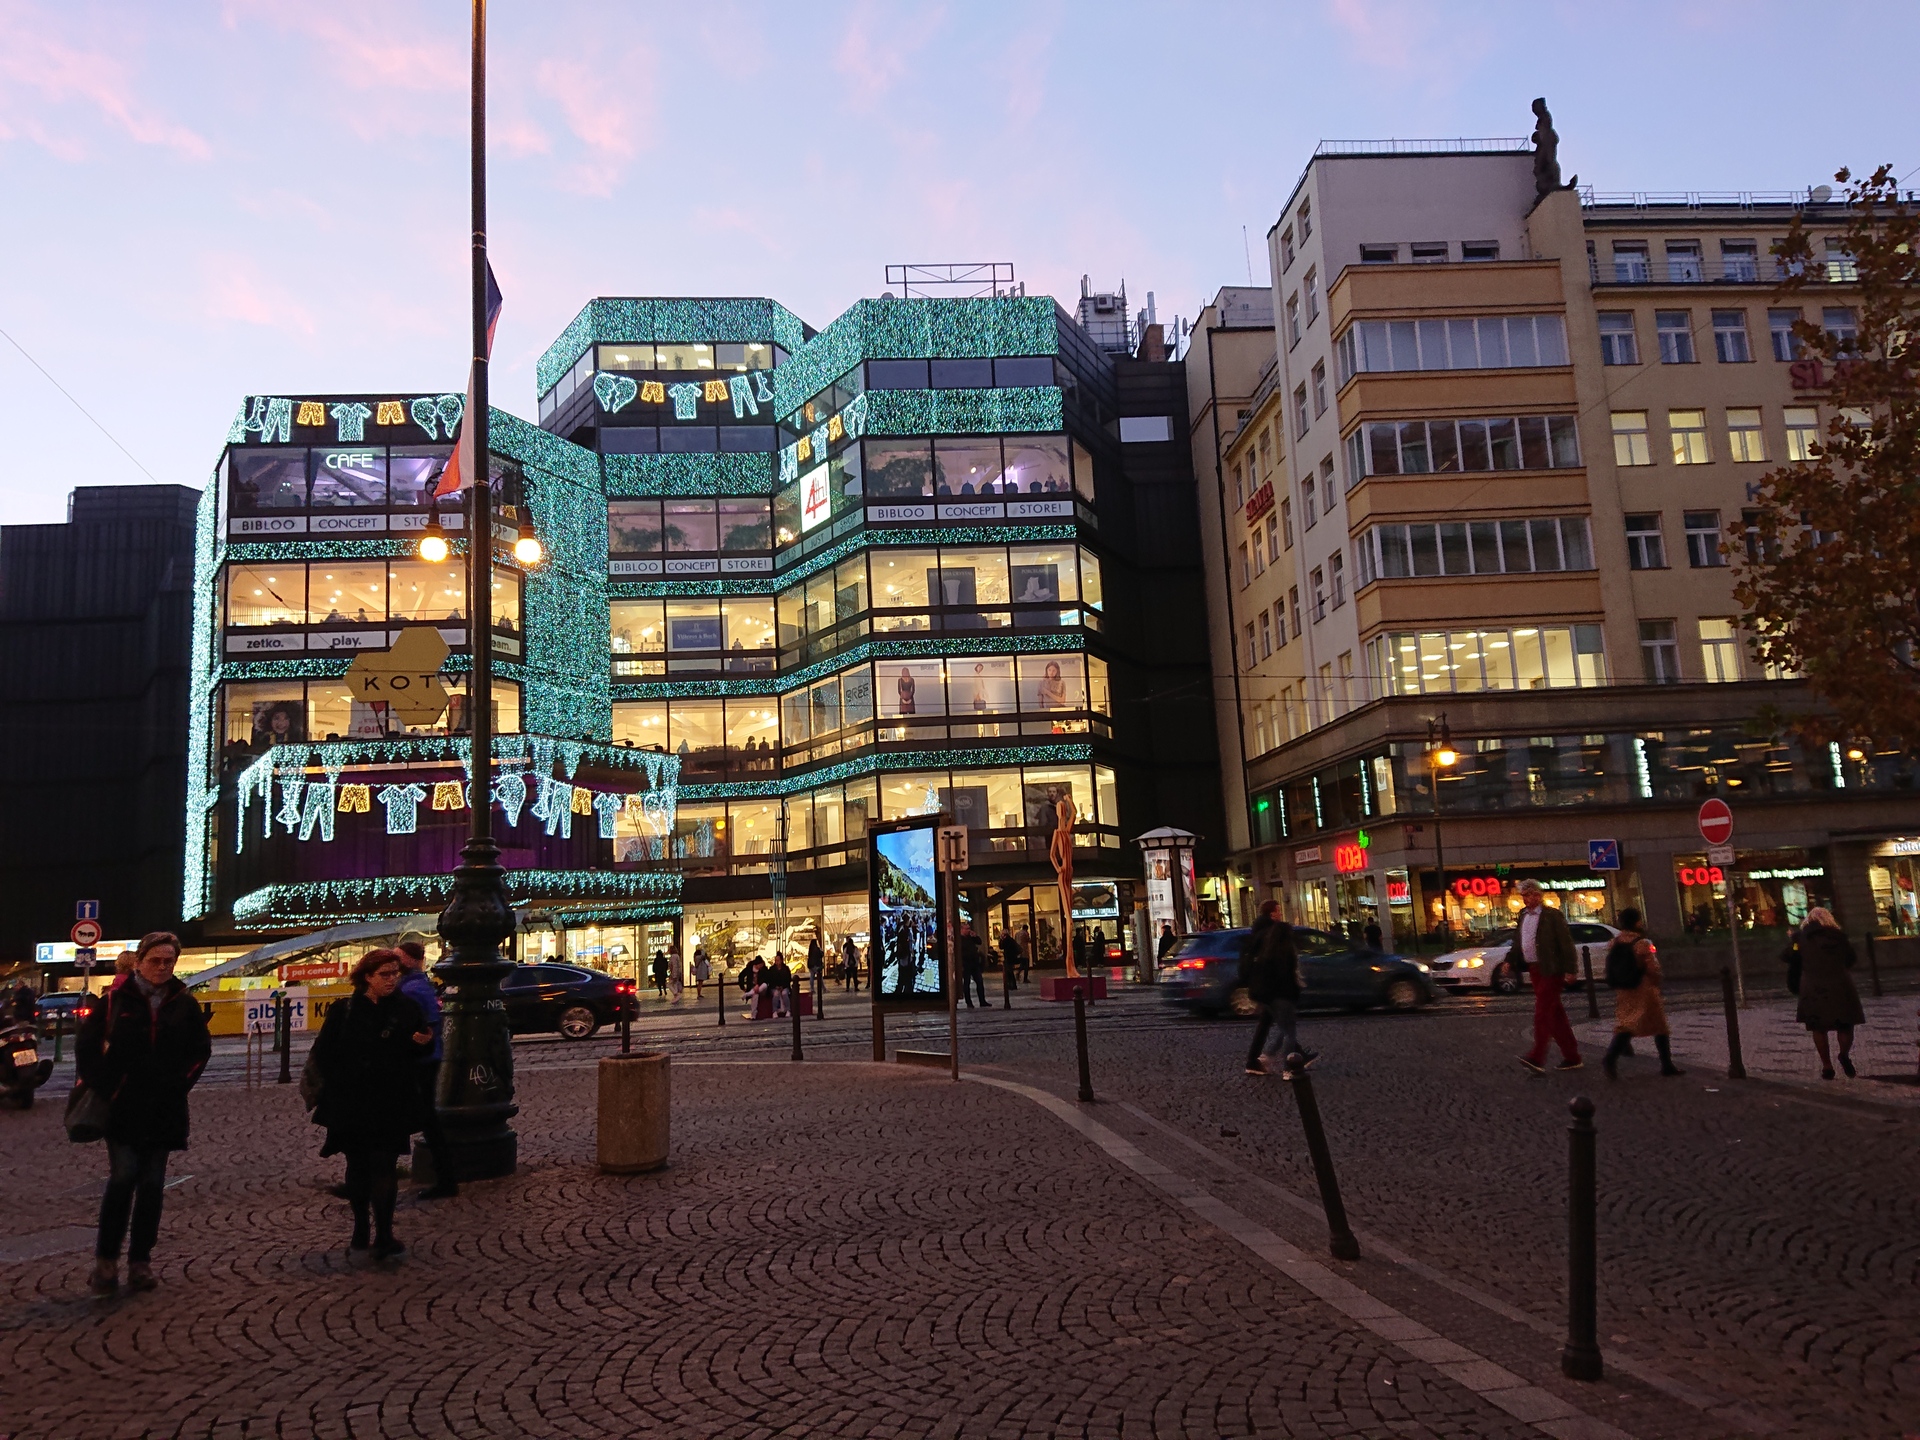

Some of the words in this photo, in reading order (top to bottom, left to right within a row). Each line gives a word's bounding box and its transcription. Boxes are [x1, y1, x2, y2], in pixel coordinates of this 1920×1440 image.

[326, 453, 373, 469] CAFE
[878, 507, 924, 519] BIBLOO
[945, 506, 997, 517] CONCEPT
[1019, 503, 1062, 514] STORE!
[242, 518, 295, 531] BIBLOO
[318, 517, 378, 529] CONCEPT
[404, 516, 452, 528] STOE!
[614, 562, 658, 572] BIBLOO
[667, 561, 716, 571] CONCEPT
[727, 559, 767, 570] STORE!
[246, 638, 284, 649] zetko.
[332, 636, 362, 648] play.
[365, 674, 462, 691] KOTV
[1336, 845, 1366, 872] coa
[1680, 867, 1723, 886] coa
[1456, 877, 1501, 896] coa
[248, 1001, 304, 1020] albrt
